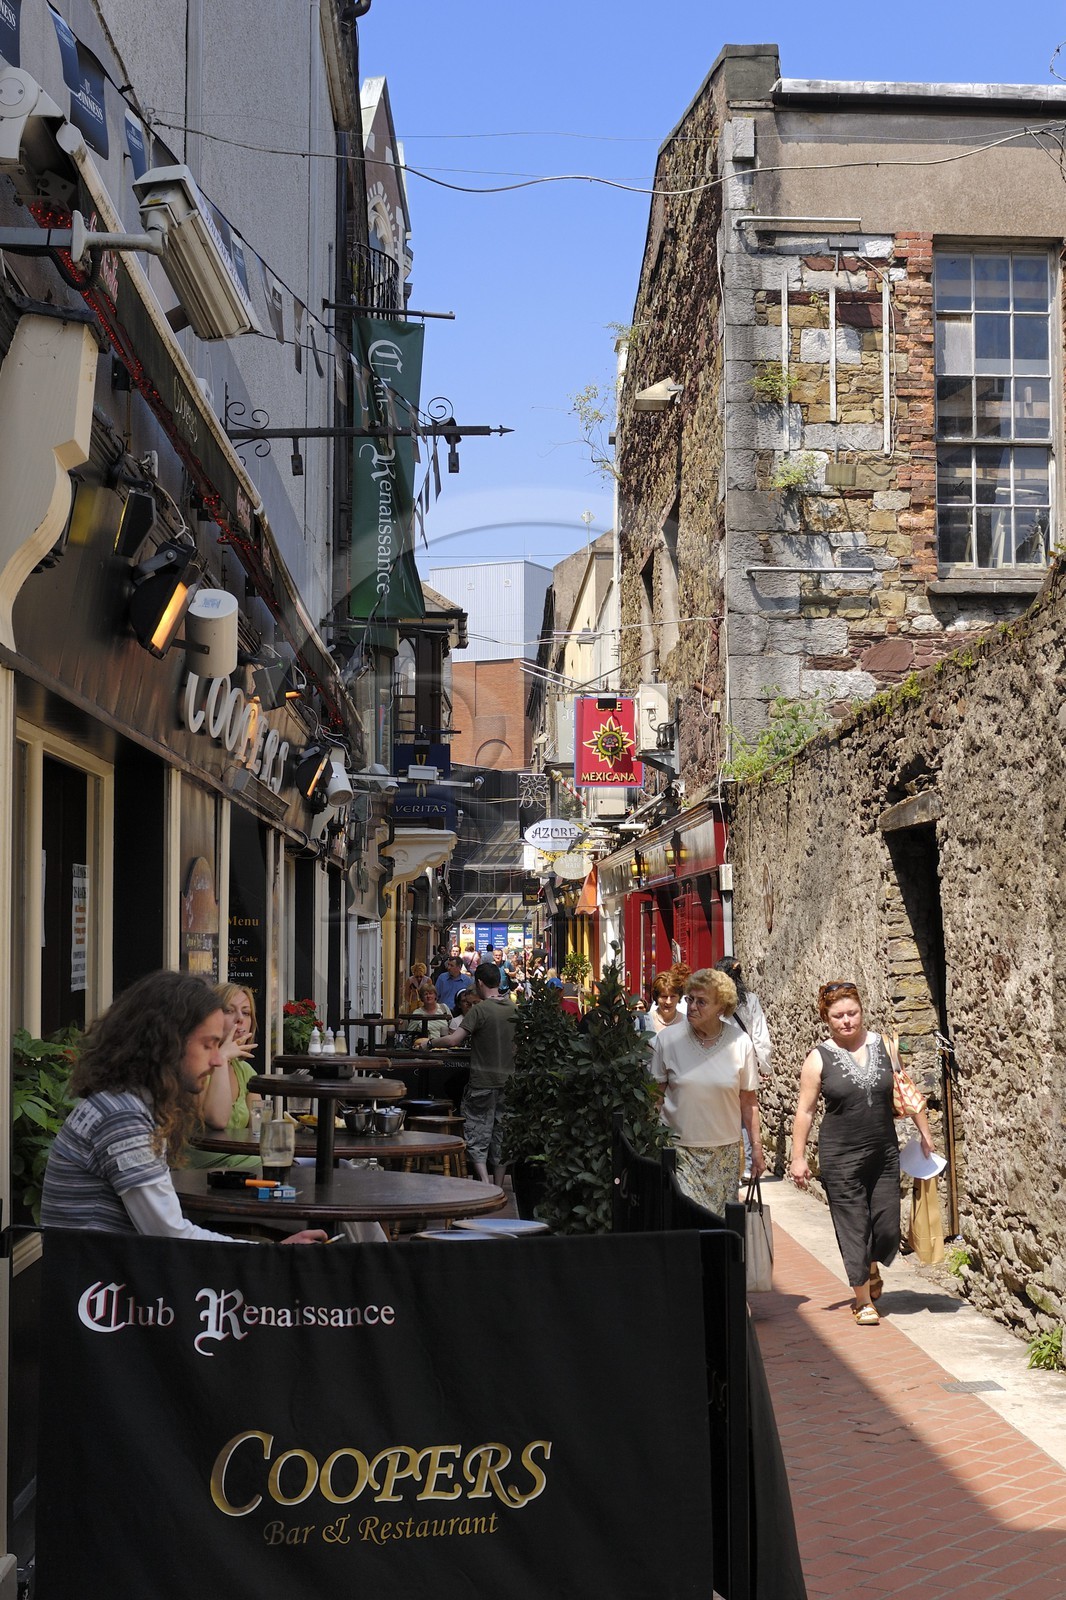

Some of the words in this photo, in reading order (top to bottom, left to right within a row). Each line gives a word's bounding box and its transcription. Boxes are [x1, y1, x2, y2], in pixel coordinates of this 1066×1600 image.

[359, 443, 396, 594] Renaissance
[581, 772, 636, 782] MEXICANA
[395, 805, 447, 813] VERITAS
[531, 827, 577, 839] AZURE
[239, 955, 259, 963] Cake
[77, 1281, 175, 1333] Club
[194, 1287, 396, 1357] Renaissance
[210, 1430, 552, 1517] COOPERS
[264, 1520, 314, 1546] Bar
[322, 1514, 352, 1543] &
[358, 1511, 499, 1544] Restaurant
